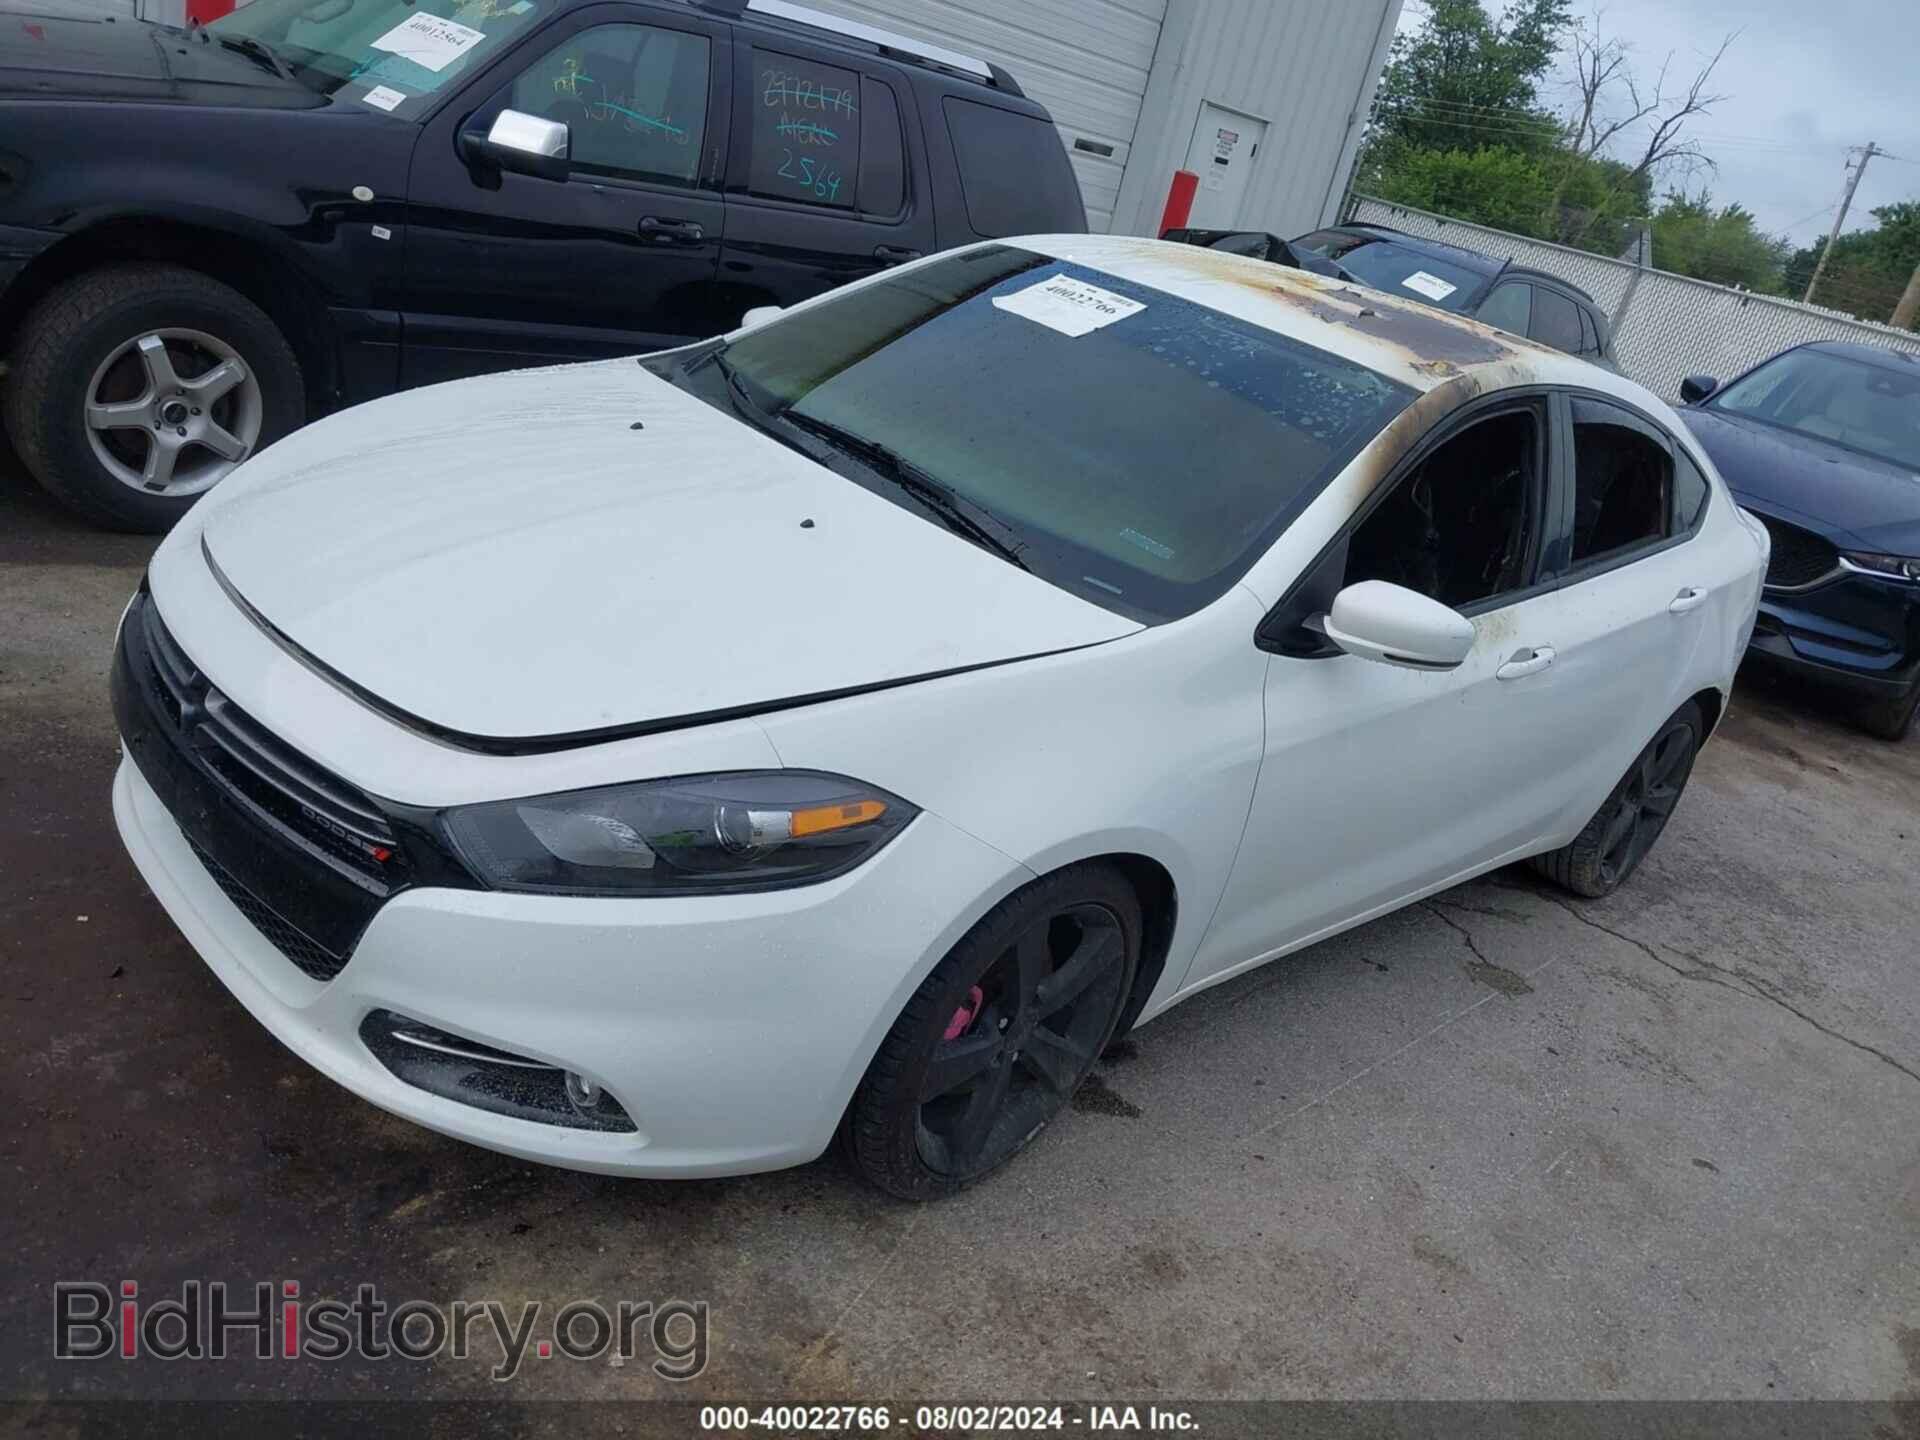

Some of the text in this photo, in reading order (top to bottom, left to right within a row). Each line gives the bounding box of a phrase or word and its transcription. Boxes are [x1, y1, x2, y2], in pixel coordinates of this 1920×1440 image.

[409, 22, 466, 47] 40012564
[777, 147, 841, 202] 2564
[1045, 285, 1116, 315] 40022766
